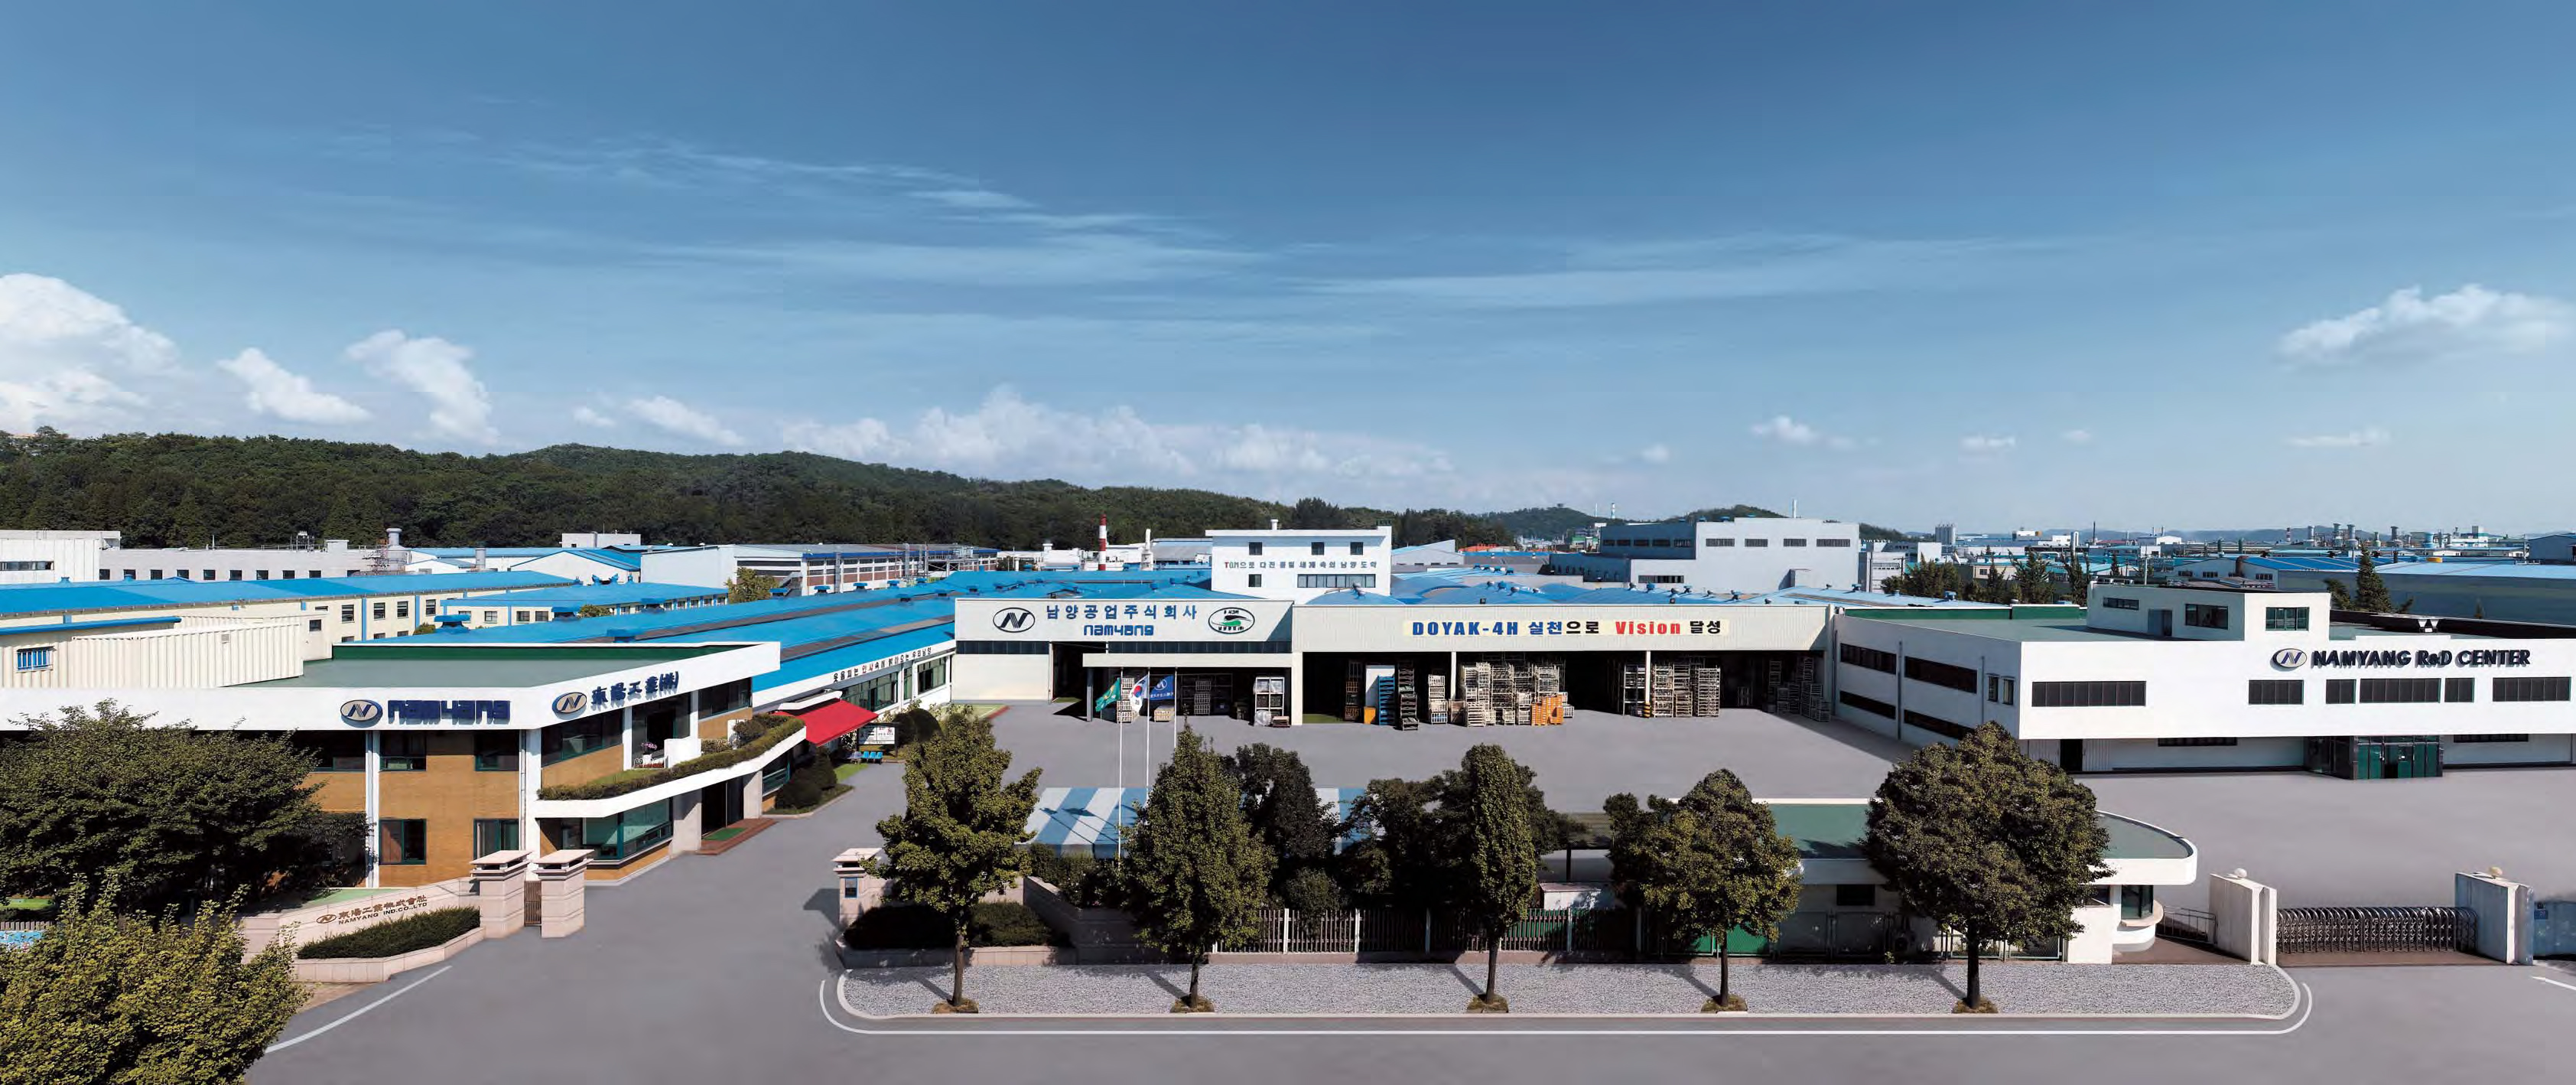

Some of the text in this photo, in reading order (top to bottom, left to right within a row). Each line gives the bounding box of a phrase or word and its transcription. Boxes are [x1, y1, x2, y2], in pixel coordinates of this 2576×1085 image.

[1046, 604, 1197, 620] 남양공업주식회사
[1412, 621, 1721, 636] DOYAK-4H 실천으로 Vision 달성
[2312, 649, 2531, 666] NAMYANG R&D CENTER
[338, 912, 379, 925] NAMYANG
